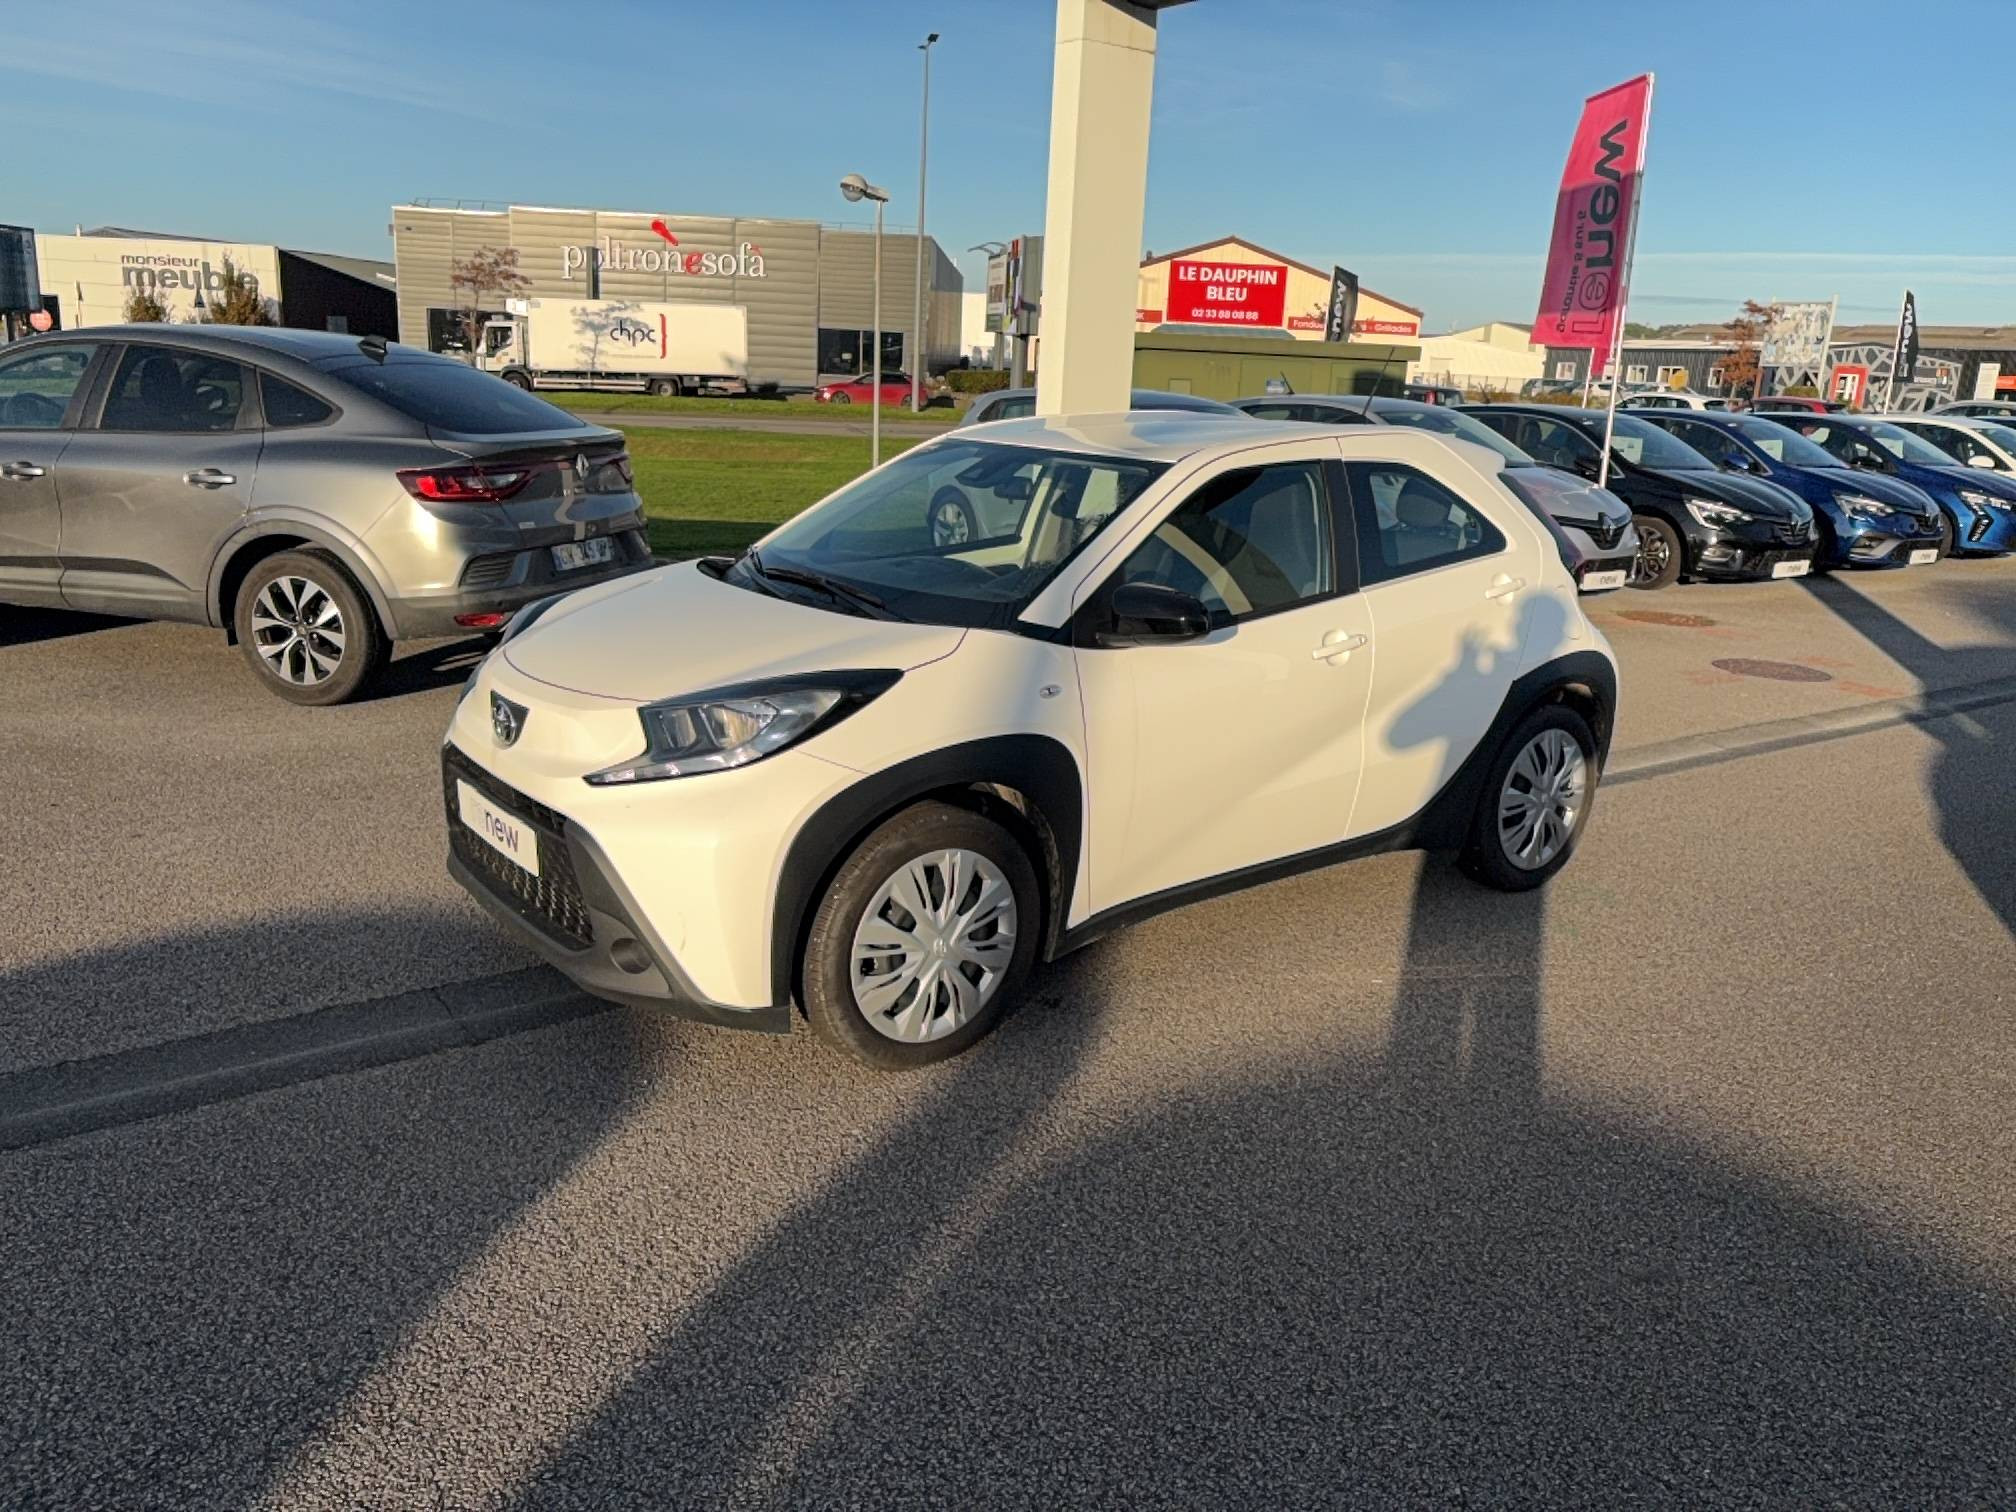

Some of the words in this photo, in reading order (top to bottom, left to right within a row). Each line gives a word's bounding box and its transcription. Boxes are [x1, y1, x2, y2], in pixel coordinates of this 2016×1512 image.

[121, 254, 199, 267] monsieur
[561, 235, 767, 280] pltronesofà
[1179, 265, 1197, 281] LE
[1199, 266, 1279, 285] DAUPHIN
[1206, 285, 1248, 301] BLEU
